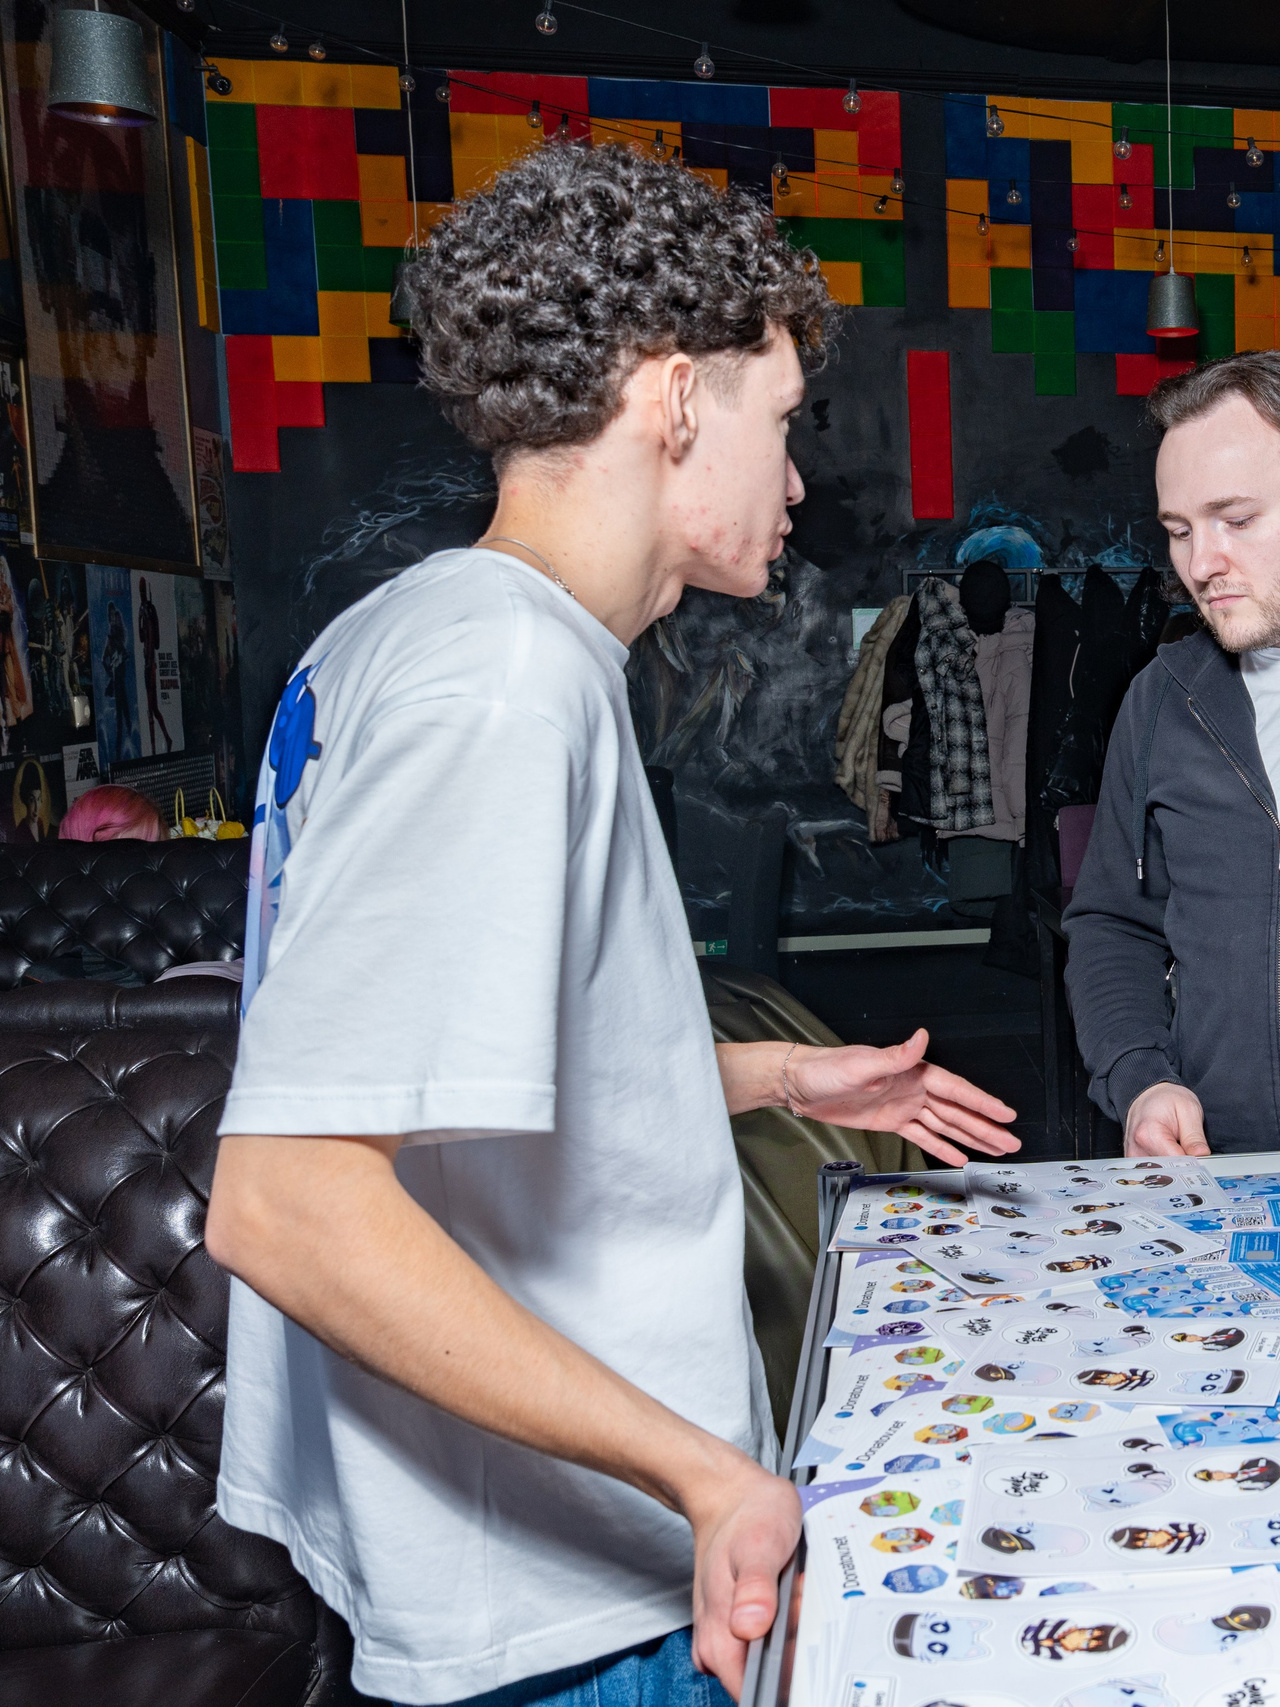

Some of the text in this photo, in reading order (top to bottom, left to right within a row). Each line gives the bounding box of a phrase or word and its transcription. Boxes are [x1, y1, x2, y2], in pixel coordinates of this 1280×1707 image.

[840, 1374, 870, 1411] Donatov.net
[856, 1420, 907, 1462] Donatov.net
[833, 1535, 860, 1589] Donatov.net
